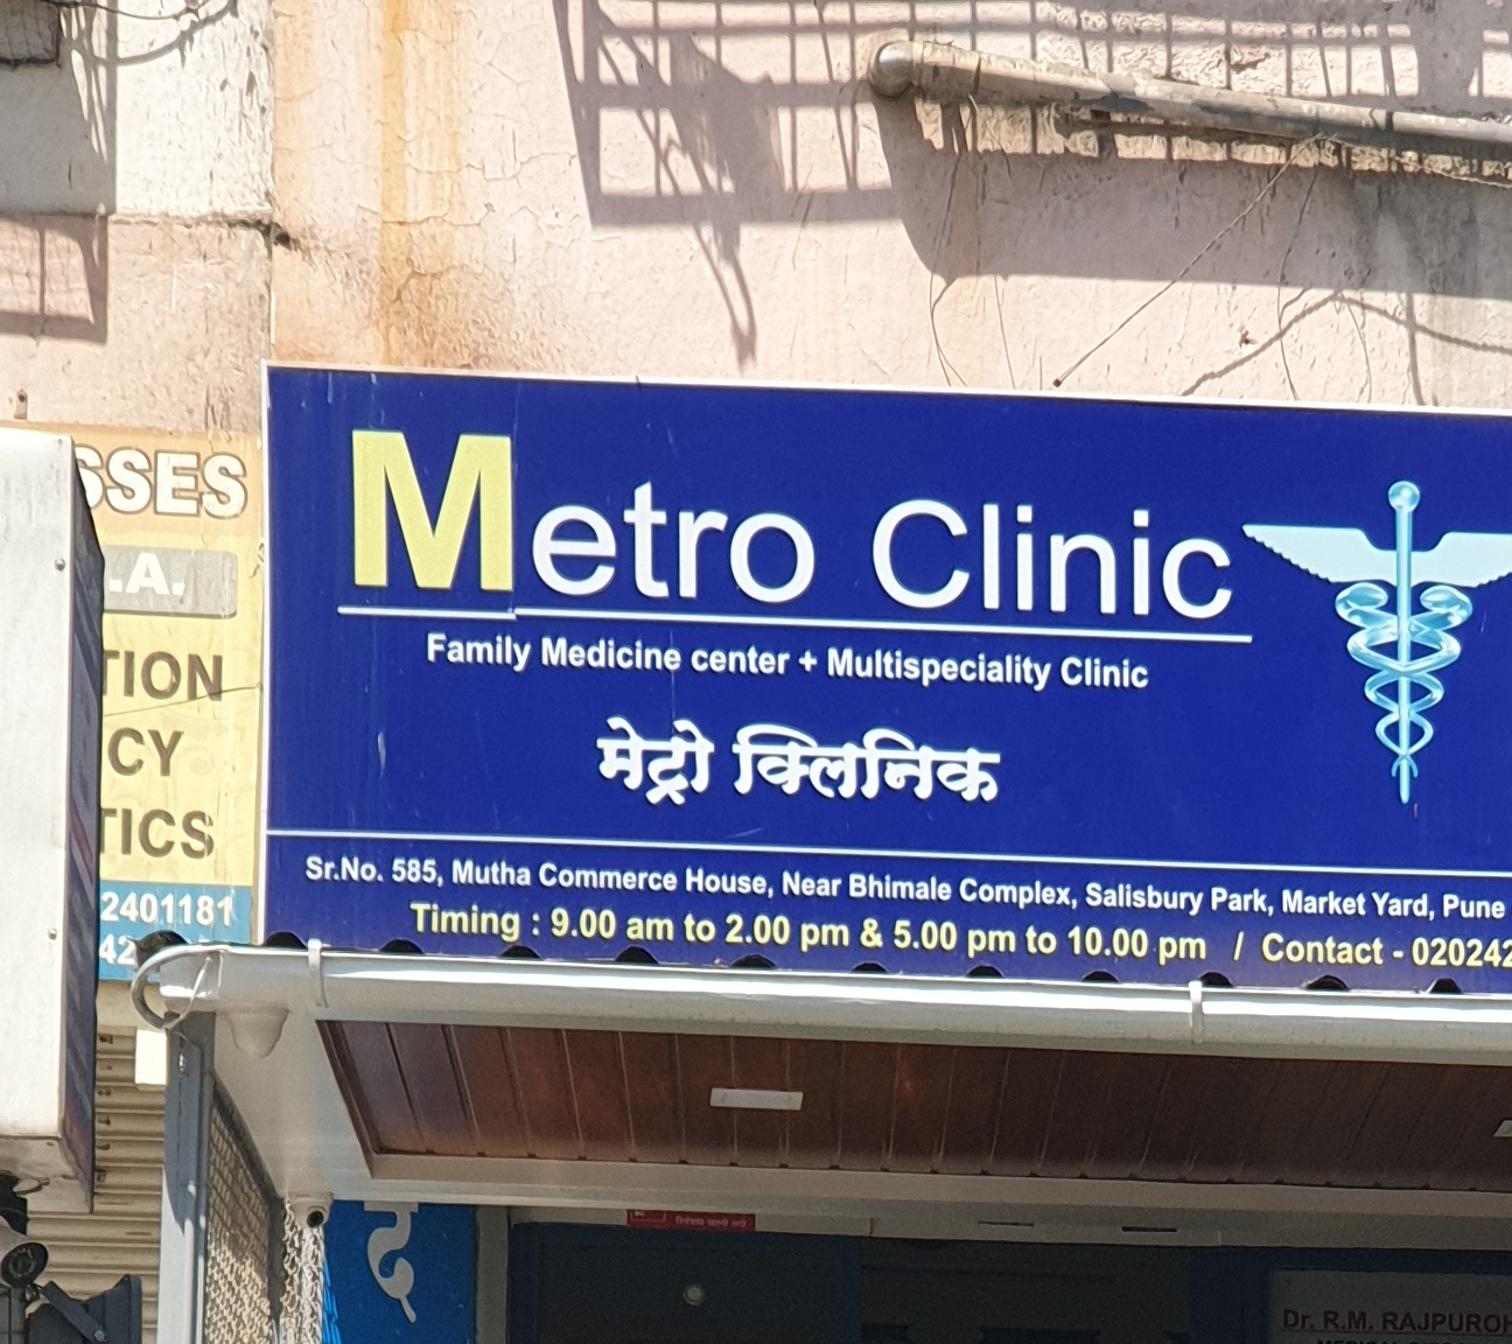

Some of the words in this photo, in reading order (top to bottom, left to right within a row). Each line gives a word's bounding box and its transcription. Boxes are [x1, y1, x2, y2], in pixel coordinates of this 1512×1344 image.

[351, 429, 815, 603] Metro
[872, 499, 1232, 619] Clinic
[427, 632, 532, 672] Family
[541, 637, 682, 671] Medicine
[691, 645, 791, 675] center
[827, 647, 1052, 692] Multispeciality
[1060, 656, 1149, 688] Clinic
[596, 716, 715, 805] मेट्रो
[731, 723, 1001, 802] क्लिनिक
[305, 855, 384, 882] Sr.No.
[391, 858, 444, 887] 585,
[452, 859, 531, 886] Mutha
[538, 862, 678, 891] Commerce
[685, 867, 774, 899] House,
[782, 870, 842, 897] Near
[849, 873, 952, 901] Bhimale
[959, 877, 1078, 910] Complex,
[1085, 882, 1204, 916] Salisbury
[1211, 886, 1274, 917] Park,
[1282, 889, 1366, 916] Market
[1371, 892, 1435, 921] Yard,
[1443, 893, 1506, 919] Pune
[410, 902, 520, 943] Timing
[551, 907, 617, 939] 9.00
[725, 913, 791, 945] 2.00
[893, 919, 958, 951] 5.00
[1067, 925, 1149, 958] 10.00
[1262, 932, 1384, 965] Contact
